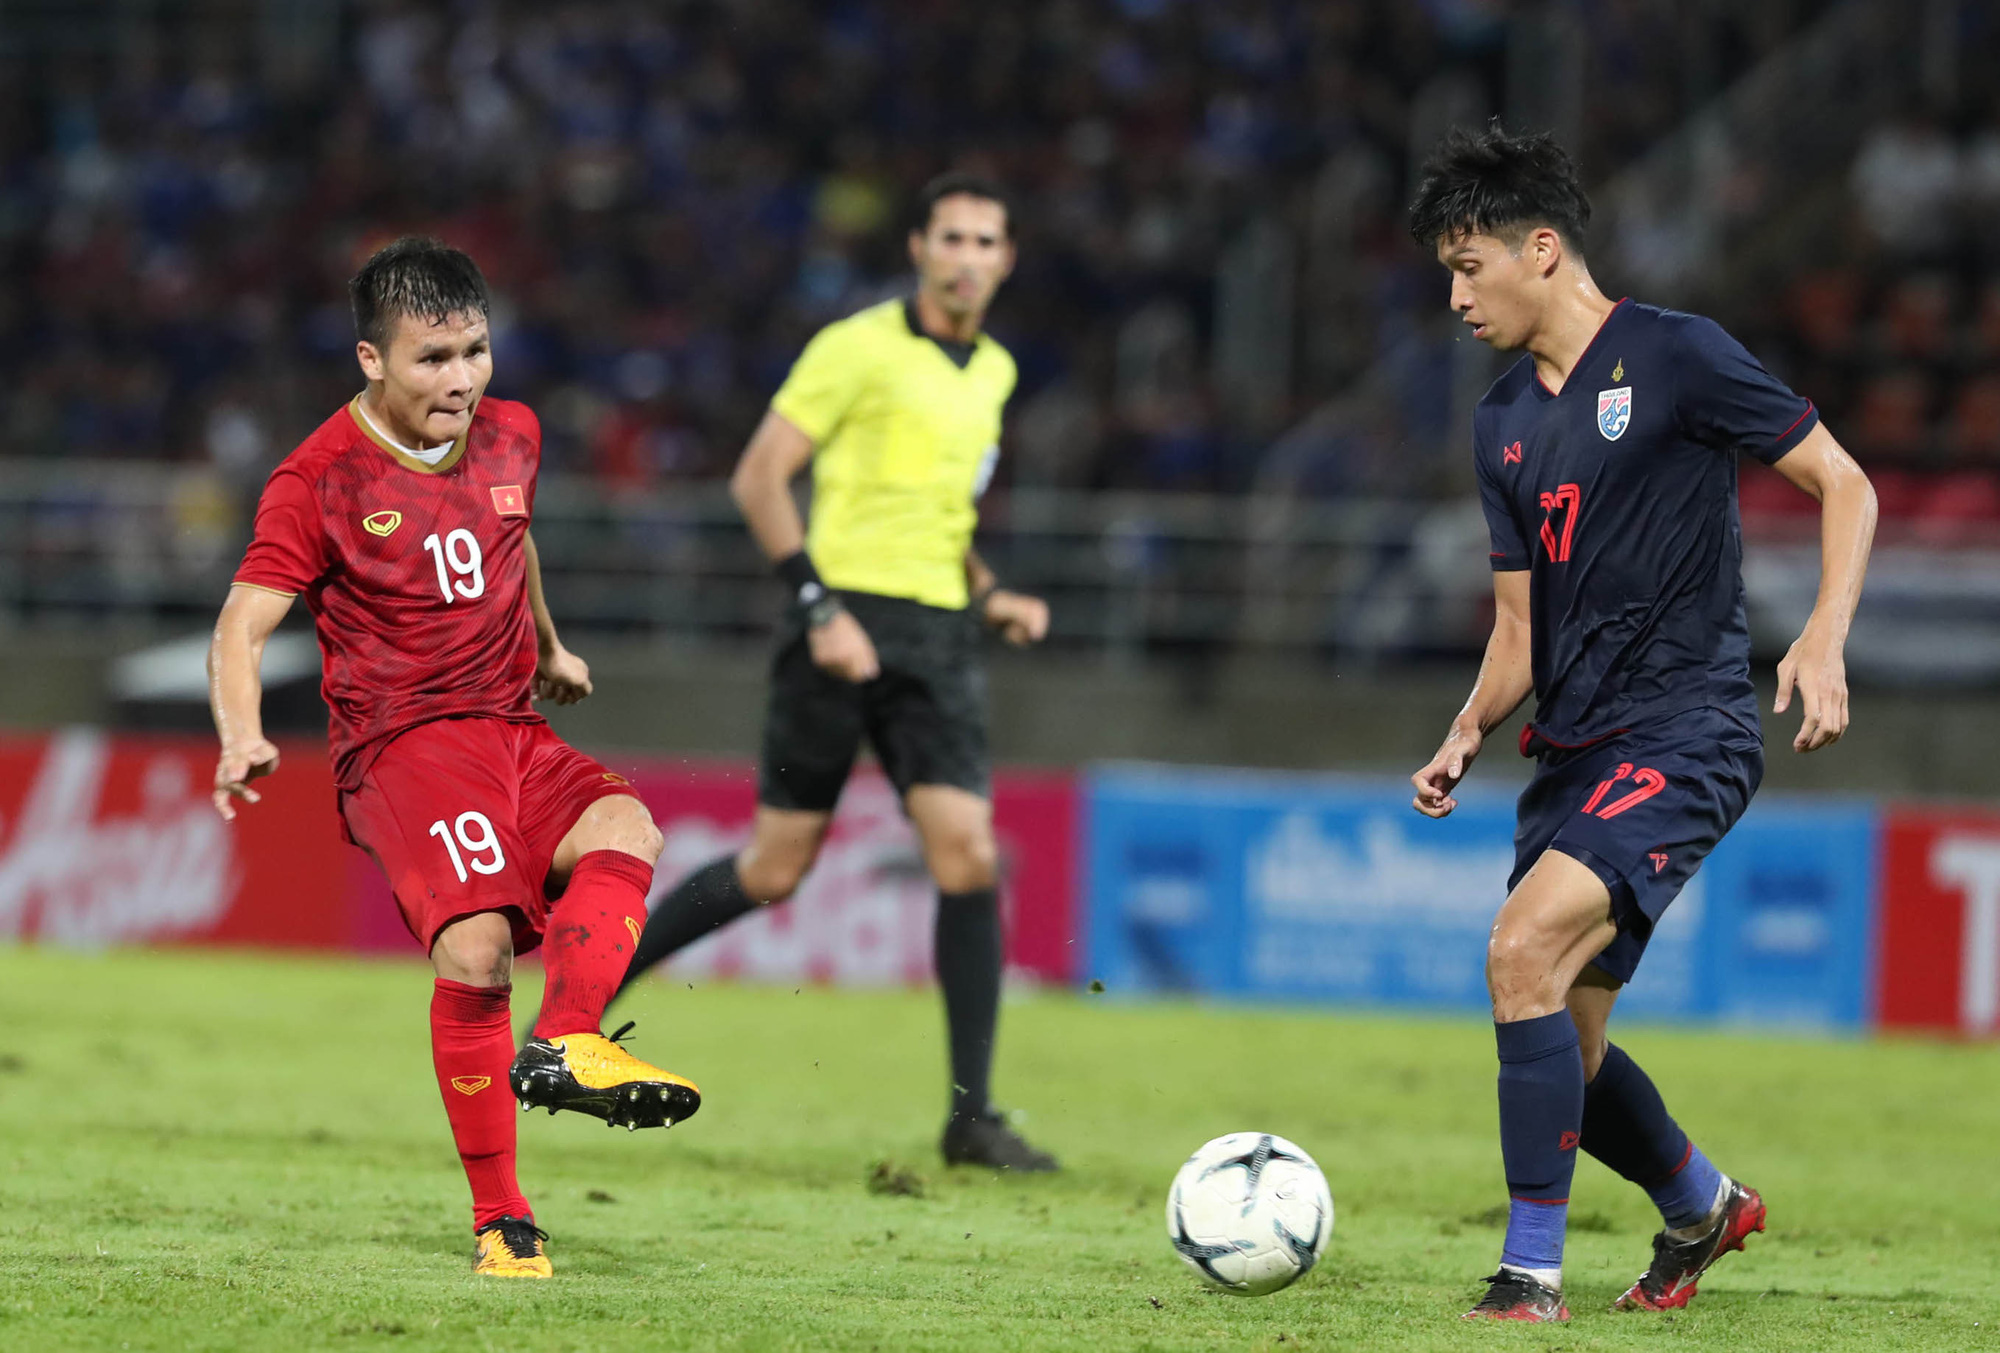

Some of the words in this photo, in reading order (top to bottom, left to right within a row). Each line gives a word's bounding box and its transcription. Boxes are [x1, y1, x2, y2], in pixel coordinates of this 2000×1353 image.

[1540, 483, 1581, 563] 17
[424, 528, 485, 604] 19
[1580, 762, 1666, 820] 17
[429, 810, 506, 883] 19
